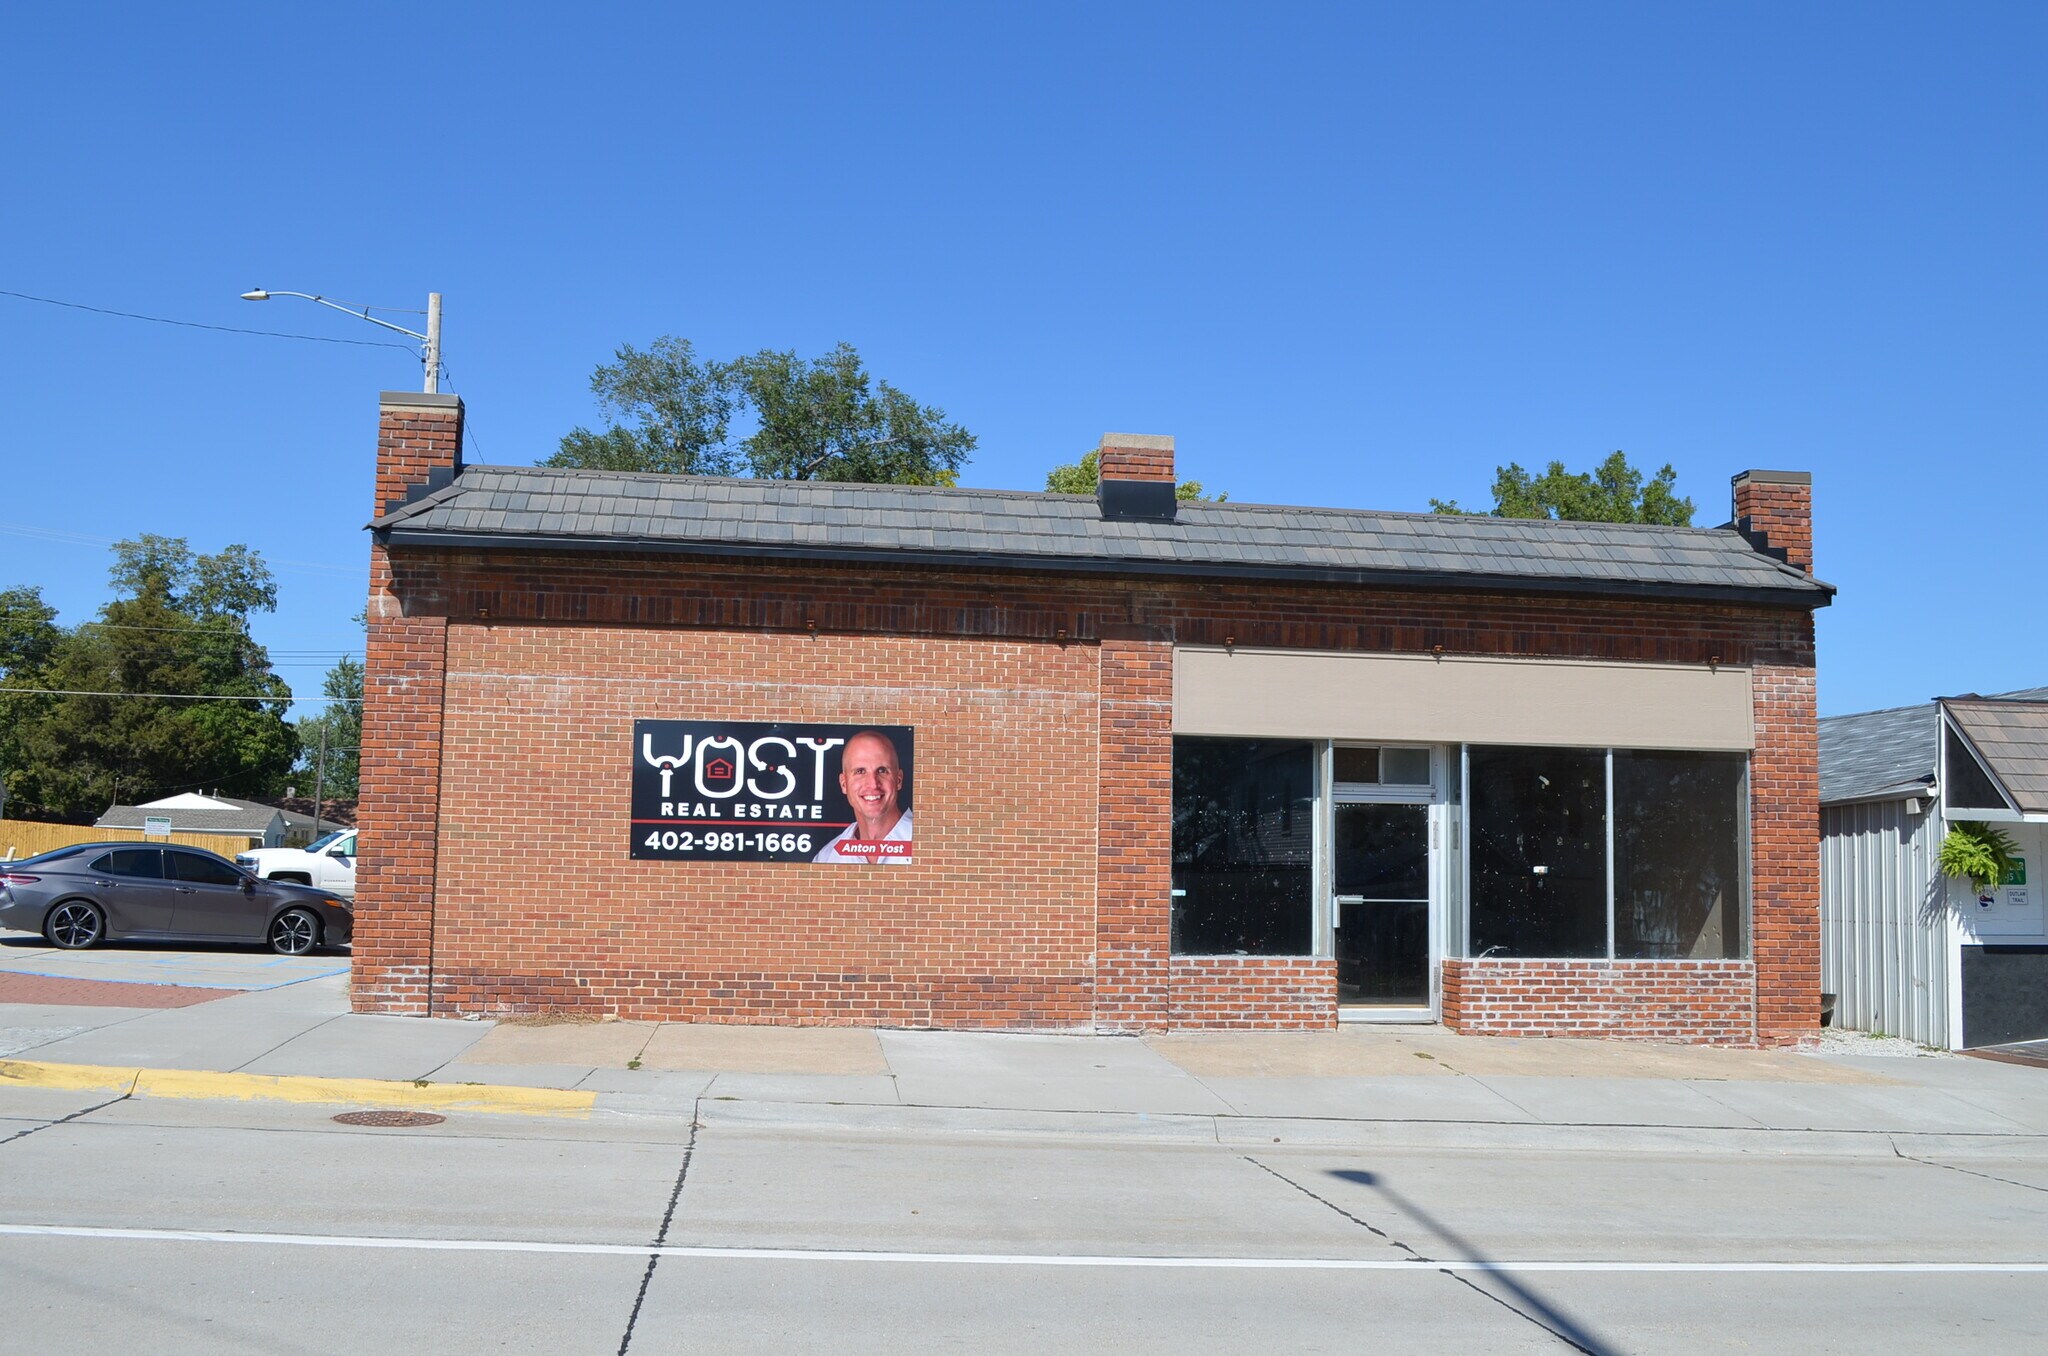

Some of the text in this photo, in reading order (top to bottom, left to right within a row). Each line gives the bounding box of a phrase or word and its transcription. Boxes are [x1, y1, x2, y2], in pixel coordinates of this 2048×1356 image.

[643, 733, 844, 800] YOST
[661, 802, 823, 819] REAL ESTATE
[644, 831, 812, 853] 402-981-1666
[842, 843, 905, 854] Anton Yost
